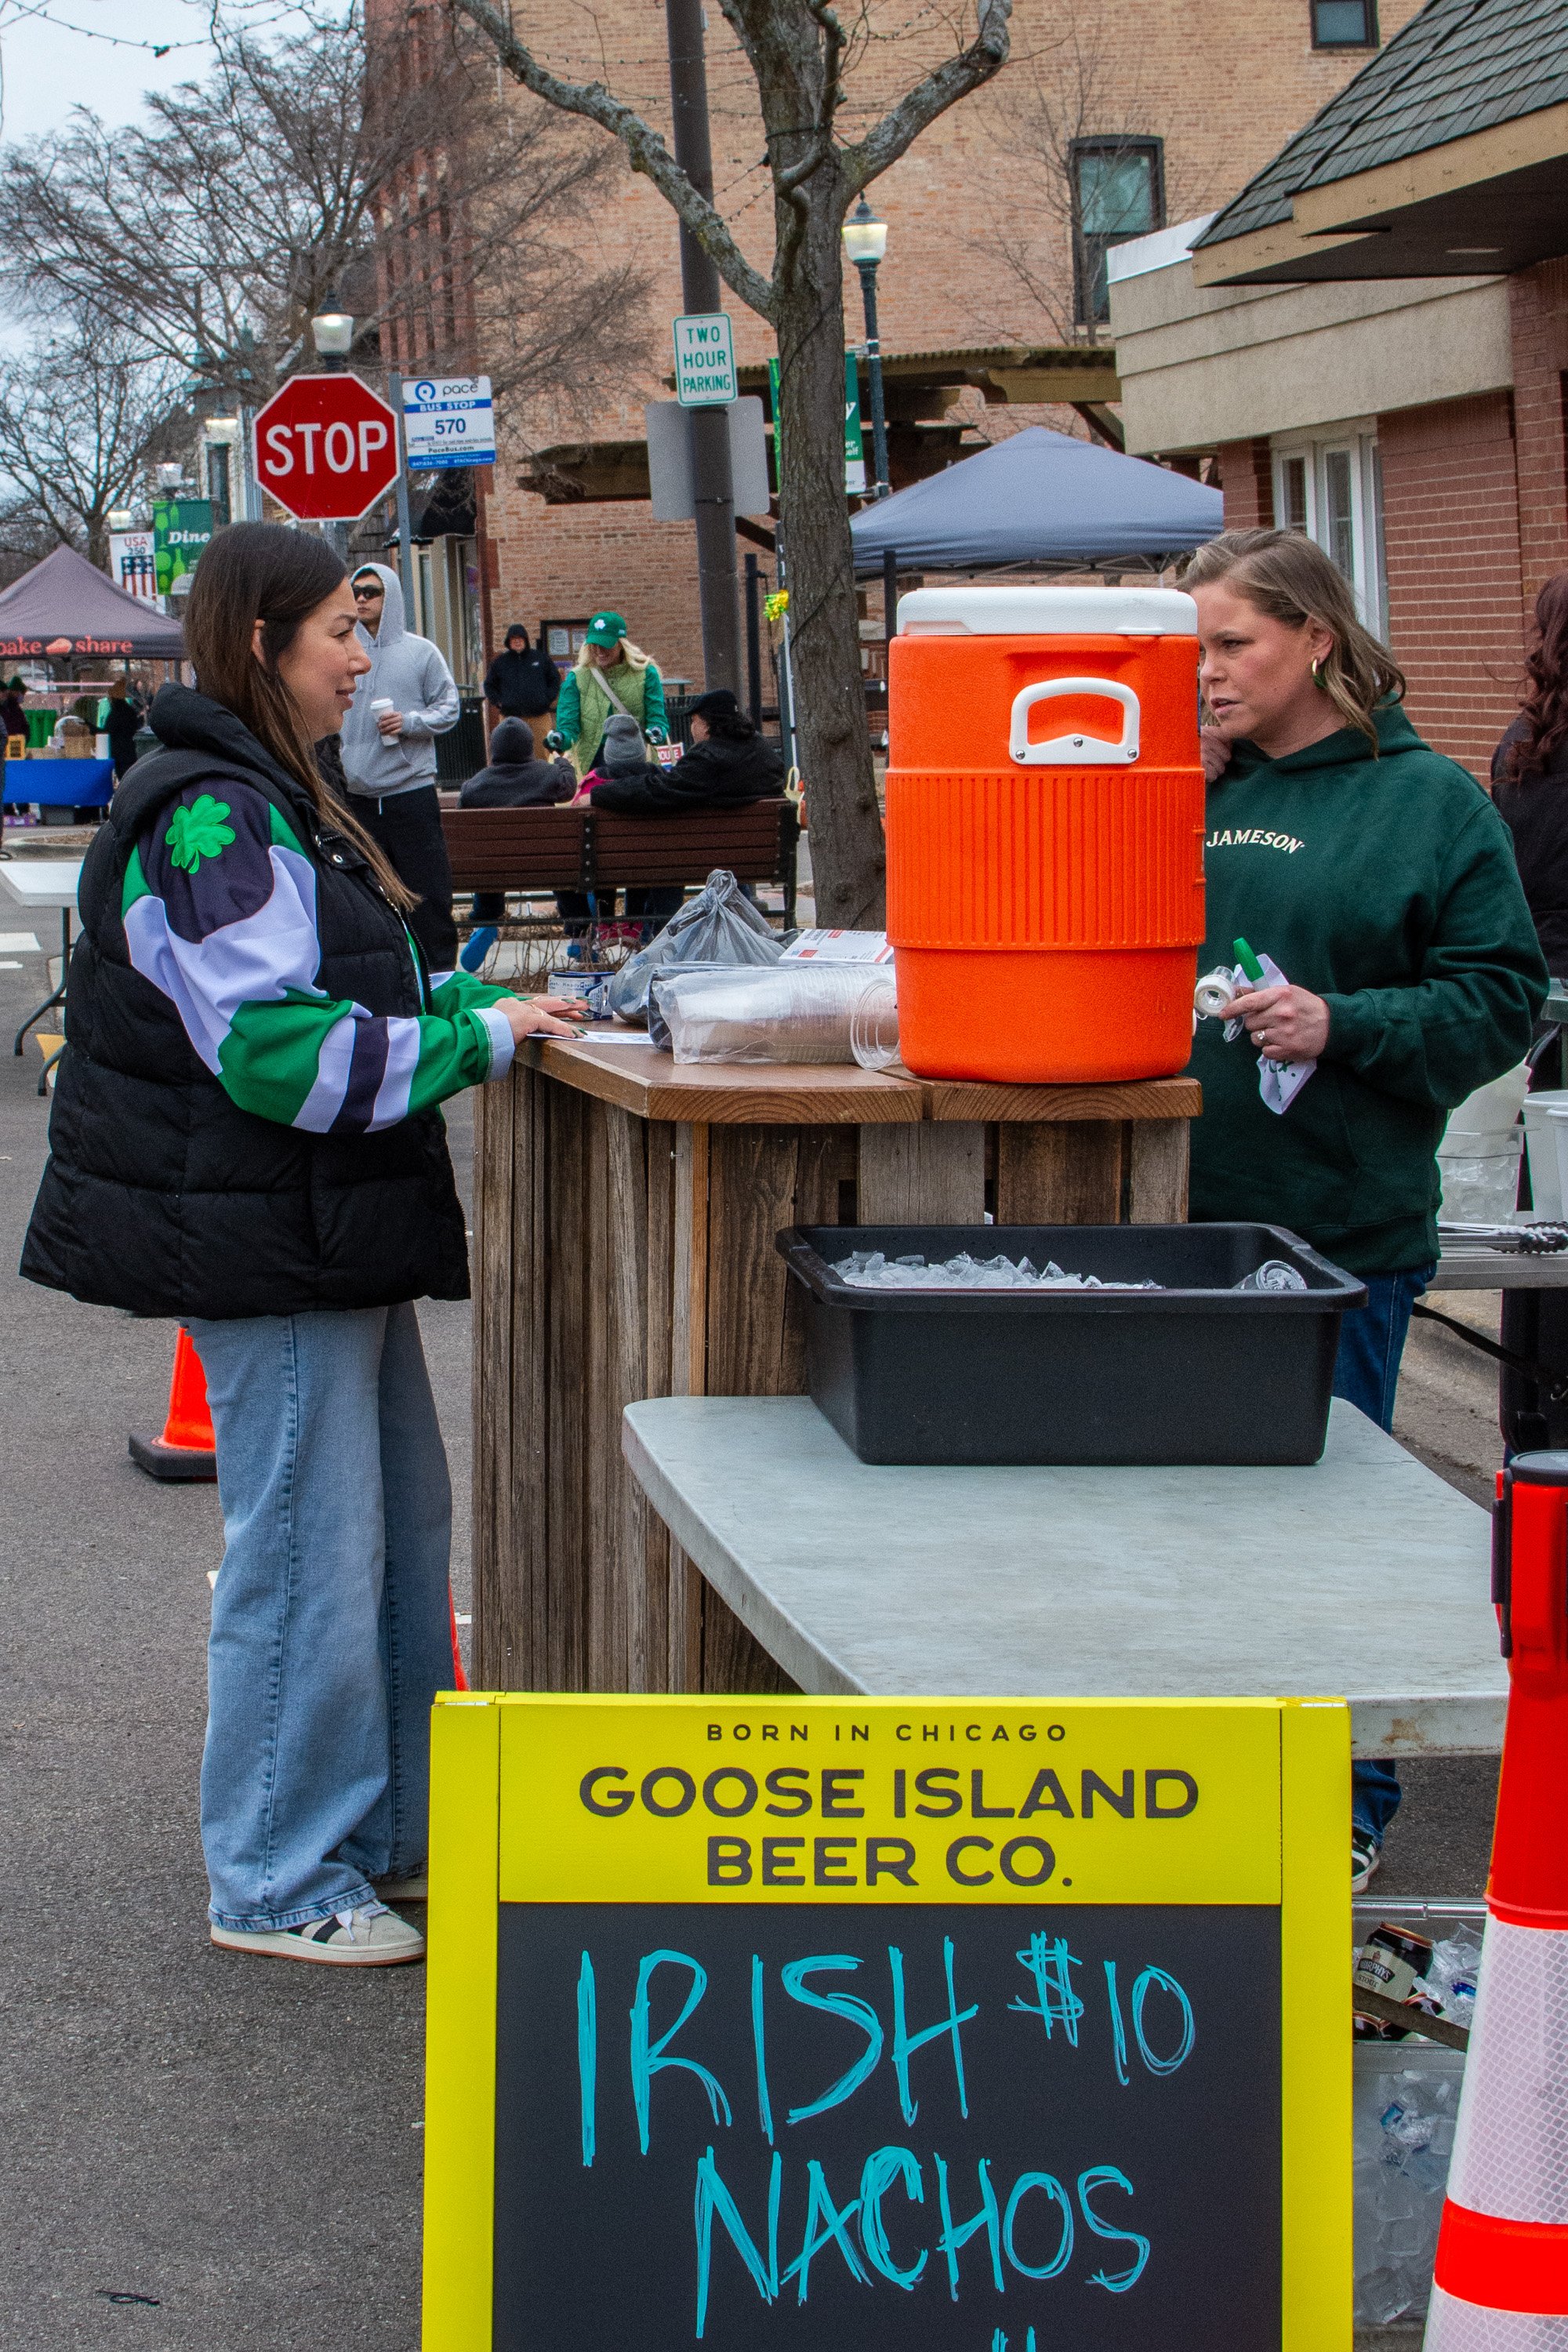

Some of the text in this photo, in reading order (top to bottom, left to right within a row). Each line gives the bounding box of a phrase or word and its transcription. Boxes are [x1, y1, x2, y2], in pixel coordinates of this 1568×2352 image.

[688, 326, 720, 343] TWO
[684, 350, 726, 368] HOUR
[442, 383, 478, 396] pace
[683, 375, 731, 393] PARKING
[419, 401, 476, 412] BUS STOP
[435, 418, 466, 434] 570
[265, 421, 387, 476] STOP
[124, 536, 148, 546] USA
[168, 529, 211, 543] Dine
[127, 546, 146, 555] 250
[75, 633, 133, 653] share
[1206, 829, 1303, 854] JAMESON
[708, 1725, 1066, 1741] BORN IN CHICAGO
[579, 1766, 1199, 1819] GOOSE ISLAND
[708, 1836, 1073, 1887] BEER CO.
[577, 1931, 1195, 2167] IRISH $10
[696, 2145, 1150, 2338] NACHOS
